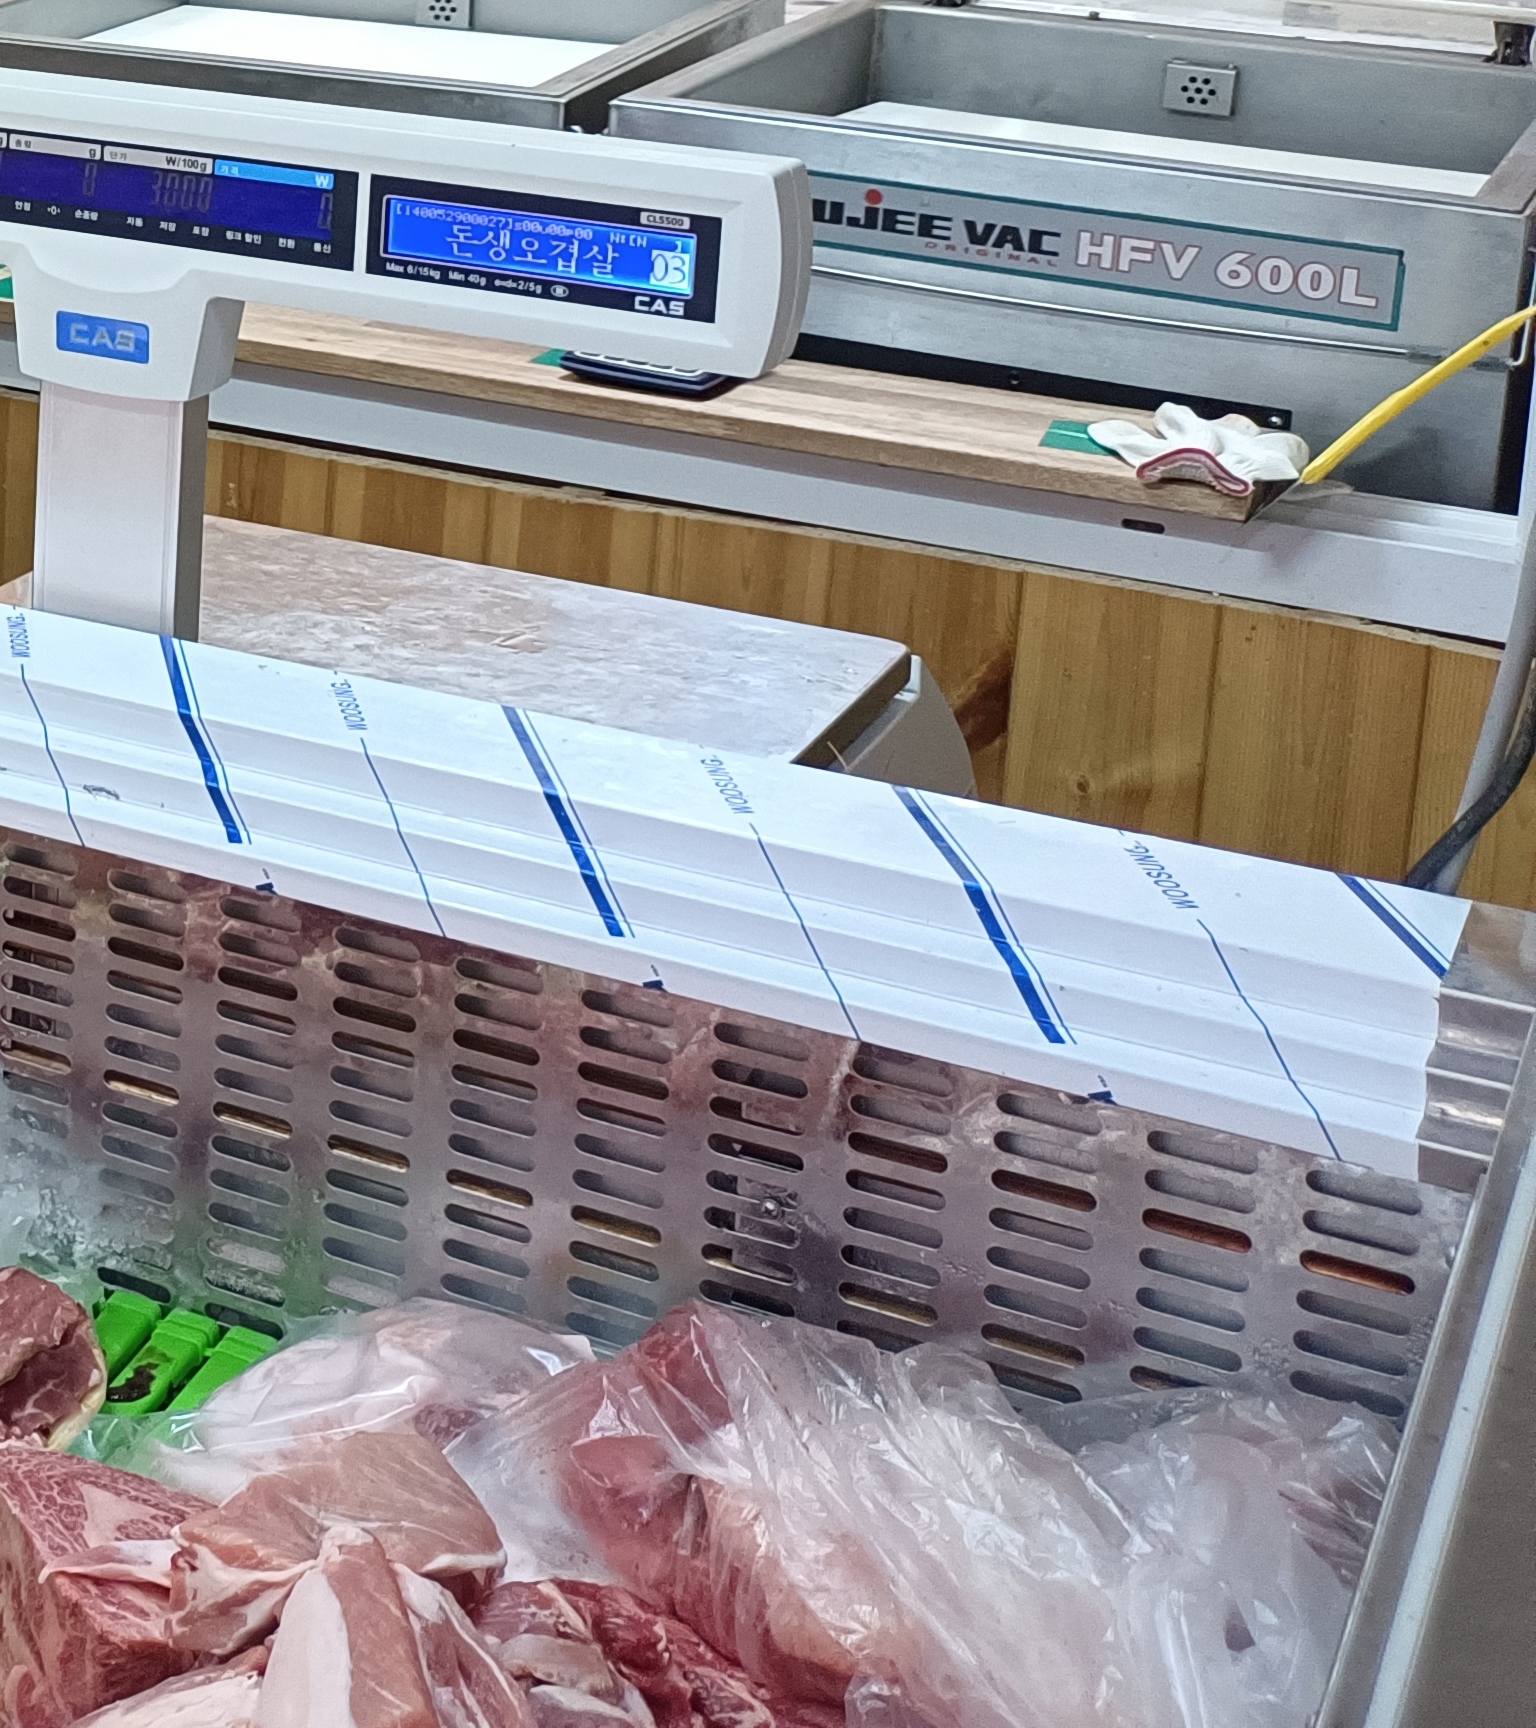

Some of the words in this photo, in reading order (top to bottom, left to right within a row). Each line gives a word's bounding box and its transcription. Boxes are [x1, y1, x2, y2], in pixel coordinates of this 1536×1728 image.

[445, 225, 619, 279] 돈생오겹살
[963, 219, 1062, 257] VAC
[385, 261, 405, 273] Max
[448, 270, 466, 282] Min
[652, 253, 688, 285] 03
[1076, 229, 1203, 281] HFV
[1216, 250, 1378, 310] 600L
[633, 295, 686, 316] CAS
[70, 322, 135, 353] CAS
[700, 754, 755, 814] WOOSUNG
[1123, 840, 1199, 909] WOOSUNG
